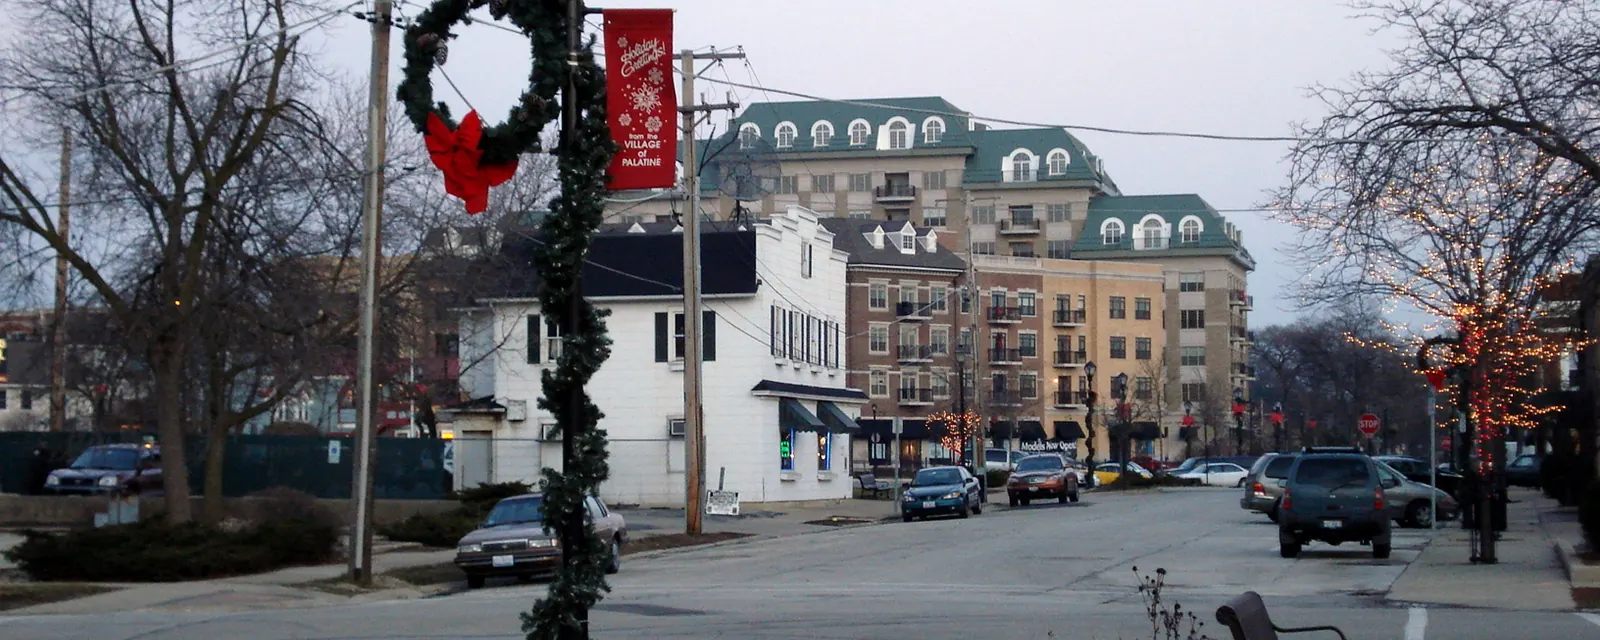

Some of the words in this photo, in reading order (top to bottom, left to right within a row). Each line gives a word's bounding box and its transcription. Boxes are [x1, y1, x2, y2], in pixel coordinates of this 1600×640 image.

[621, 38, 659, 62] Holiday
[621, 41, 666, 77] Greetings!
[624, 140, 661, 149] VILLAGE
[637, 149, 647, 158] of
[622, 158, 661, 167] PALATINE
[1360, 419, 1379, 428] STOP
[1021, 440, 1045, 451] Models
[1046, 441, 1059, 450] Now
